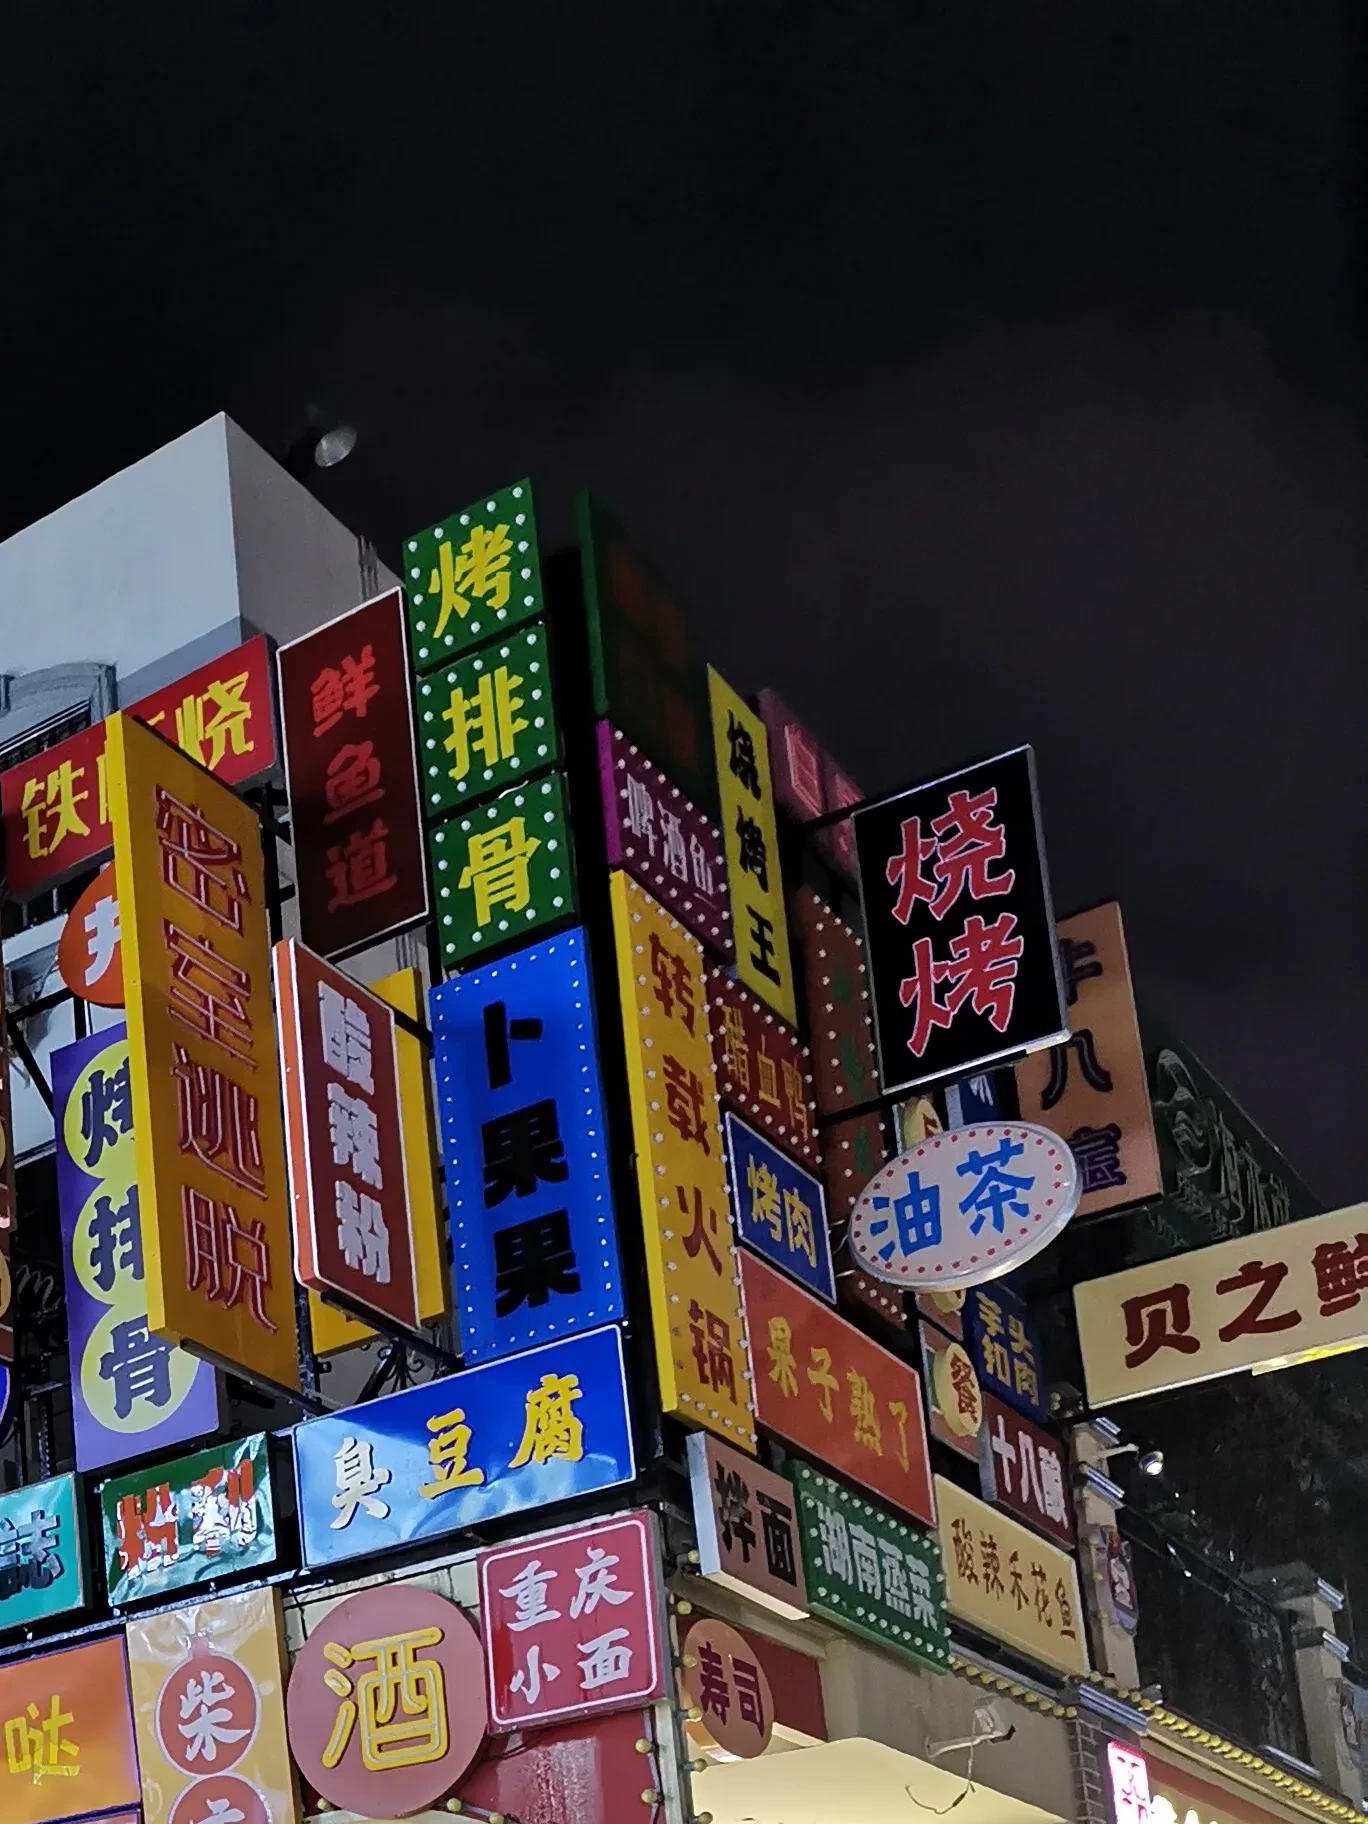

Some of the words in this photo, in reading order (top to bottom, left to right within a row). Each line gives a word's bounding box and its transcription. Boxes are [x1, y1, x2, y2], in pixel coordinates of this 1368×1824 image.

[21, 671, 255, 859] 铁烧
[310, 645, 399, 912] 鲜鱼道
[428, 523, 542, 928] 烤排骨
[626, 772, 720, 908] 啤酒鱼
[886, 786, 1024, 1057] 烧烤
[154, 784, 277, 1335] 密室逃脱
[481, 1001, 581, 1318] 卜果果
[747, 1153, 817, 1268] 烤肉
[869, 1139, 1036, 1262] 油茶
[330, 1373, 585, 1530] 臭豆腐
[767, 1316, 909, 1473] 果子熟了
[499, 1546, 634, 1632] 重庆
[817, 1501, 938, 1632] 湖南蒸菜
[322, 1627, 450, 1773] 酒
[509, 1628, 633, 1704] 小面
[698, 1641, 764, 1737] 寿司
